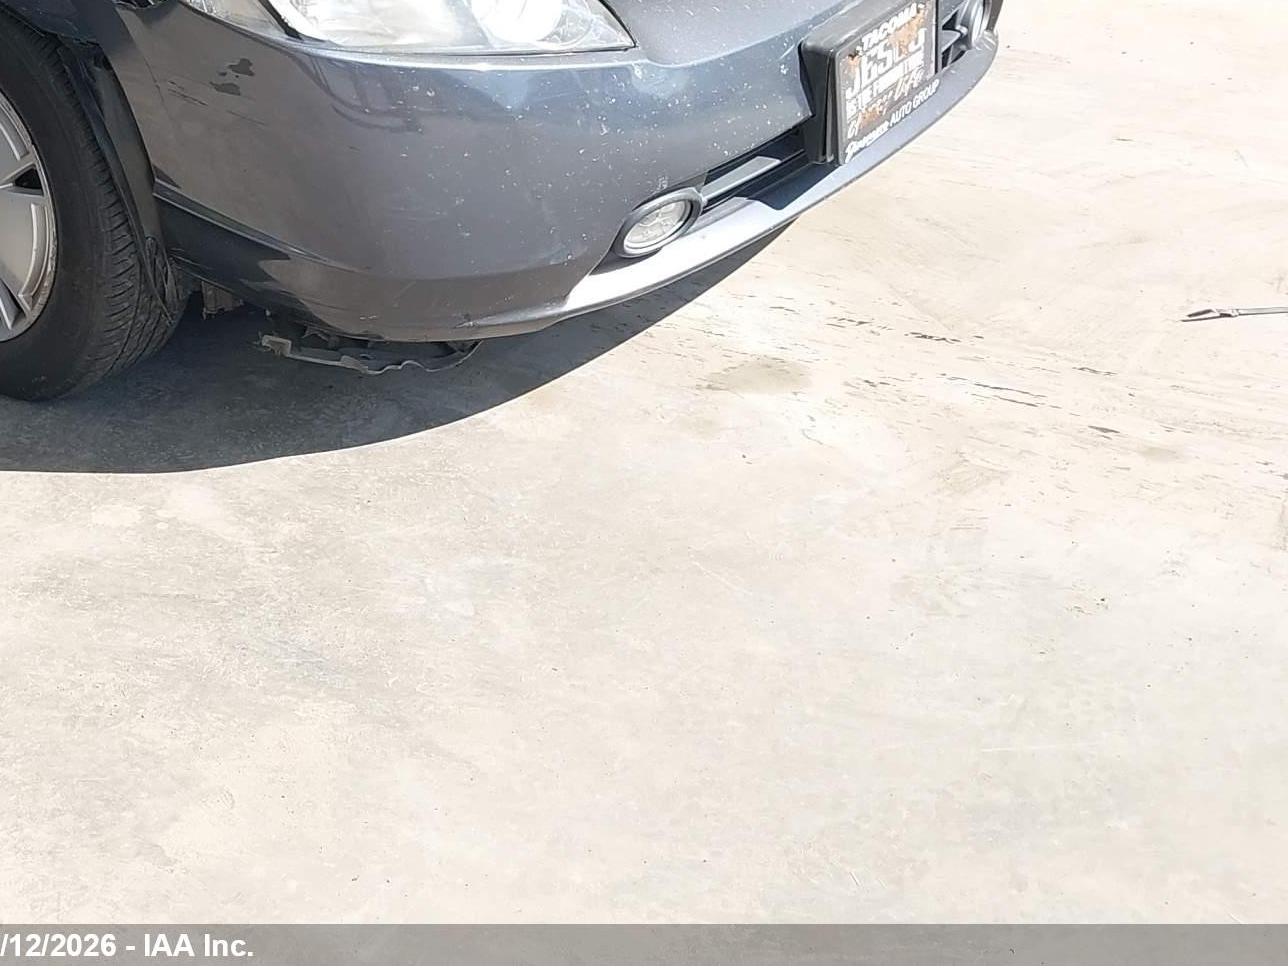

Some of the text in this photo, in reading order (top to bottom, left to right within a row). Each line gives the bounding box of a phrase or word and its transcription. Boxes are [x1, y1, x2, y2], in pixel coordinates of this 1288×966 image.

[862, 2, 916, 50] TACOMA
[890, 101, 912, 127] AUTO
[912, 78, 939, 111] GROUP
